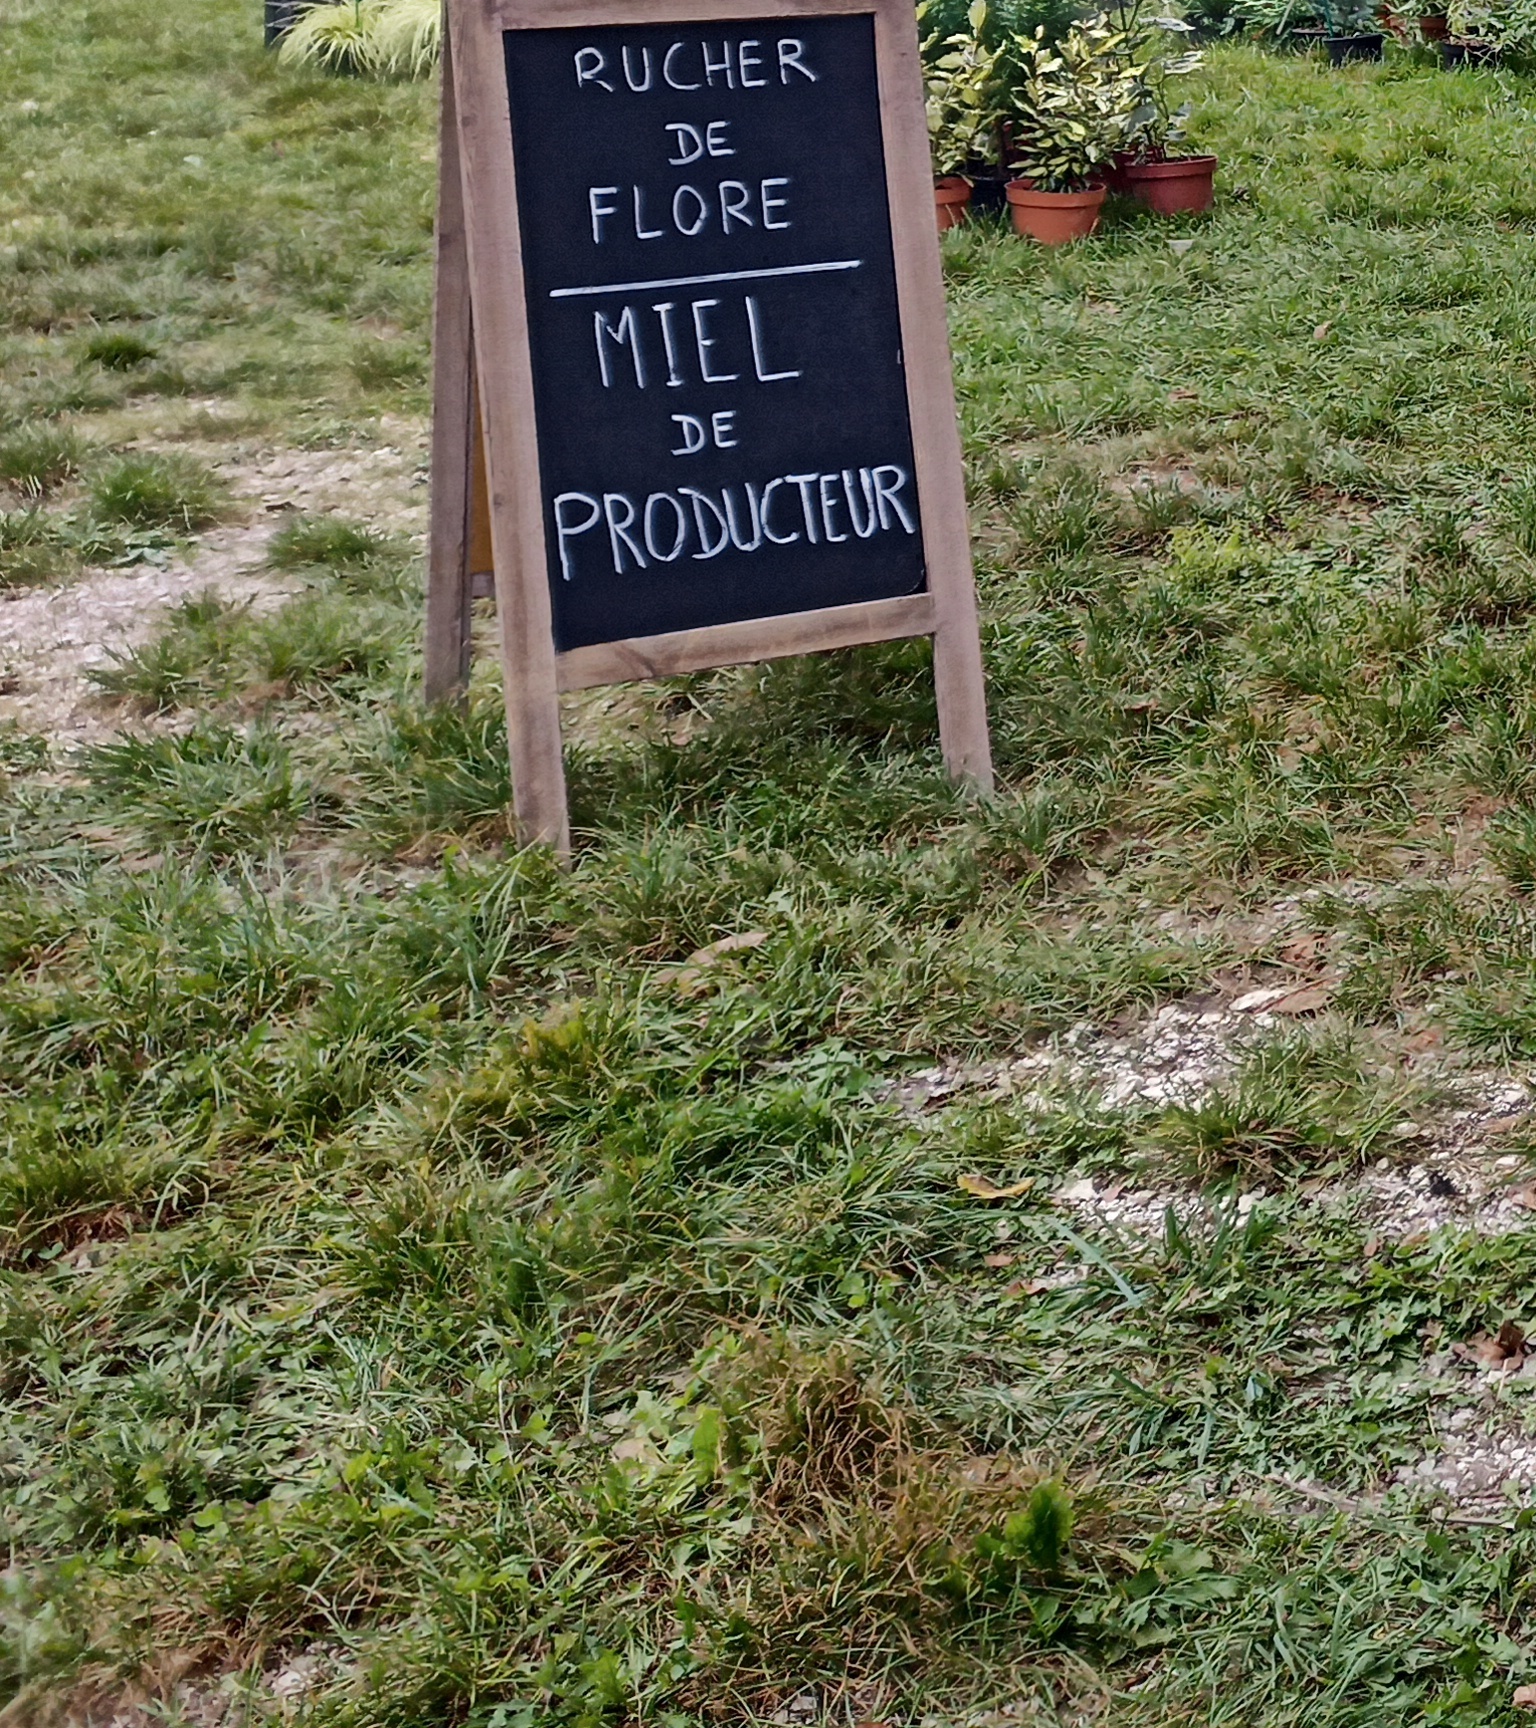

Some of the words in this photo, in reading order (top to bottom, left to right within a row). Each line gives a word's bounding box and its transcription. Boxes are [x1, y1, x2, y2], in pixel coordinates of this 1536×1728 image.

[573, 38, 820, 93] RUCHER
[665, 120, 737, 167] DE
[590, 177, 793, 244] FLORE
[593, 295, 801, 390] MIEL
[670, 410, 738, 457] DE
[553, 464, 917, 582] PRODUCTEUR
